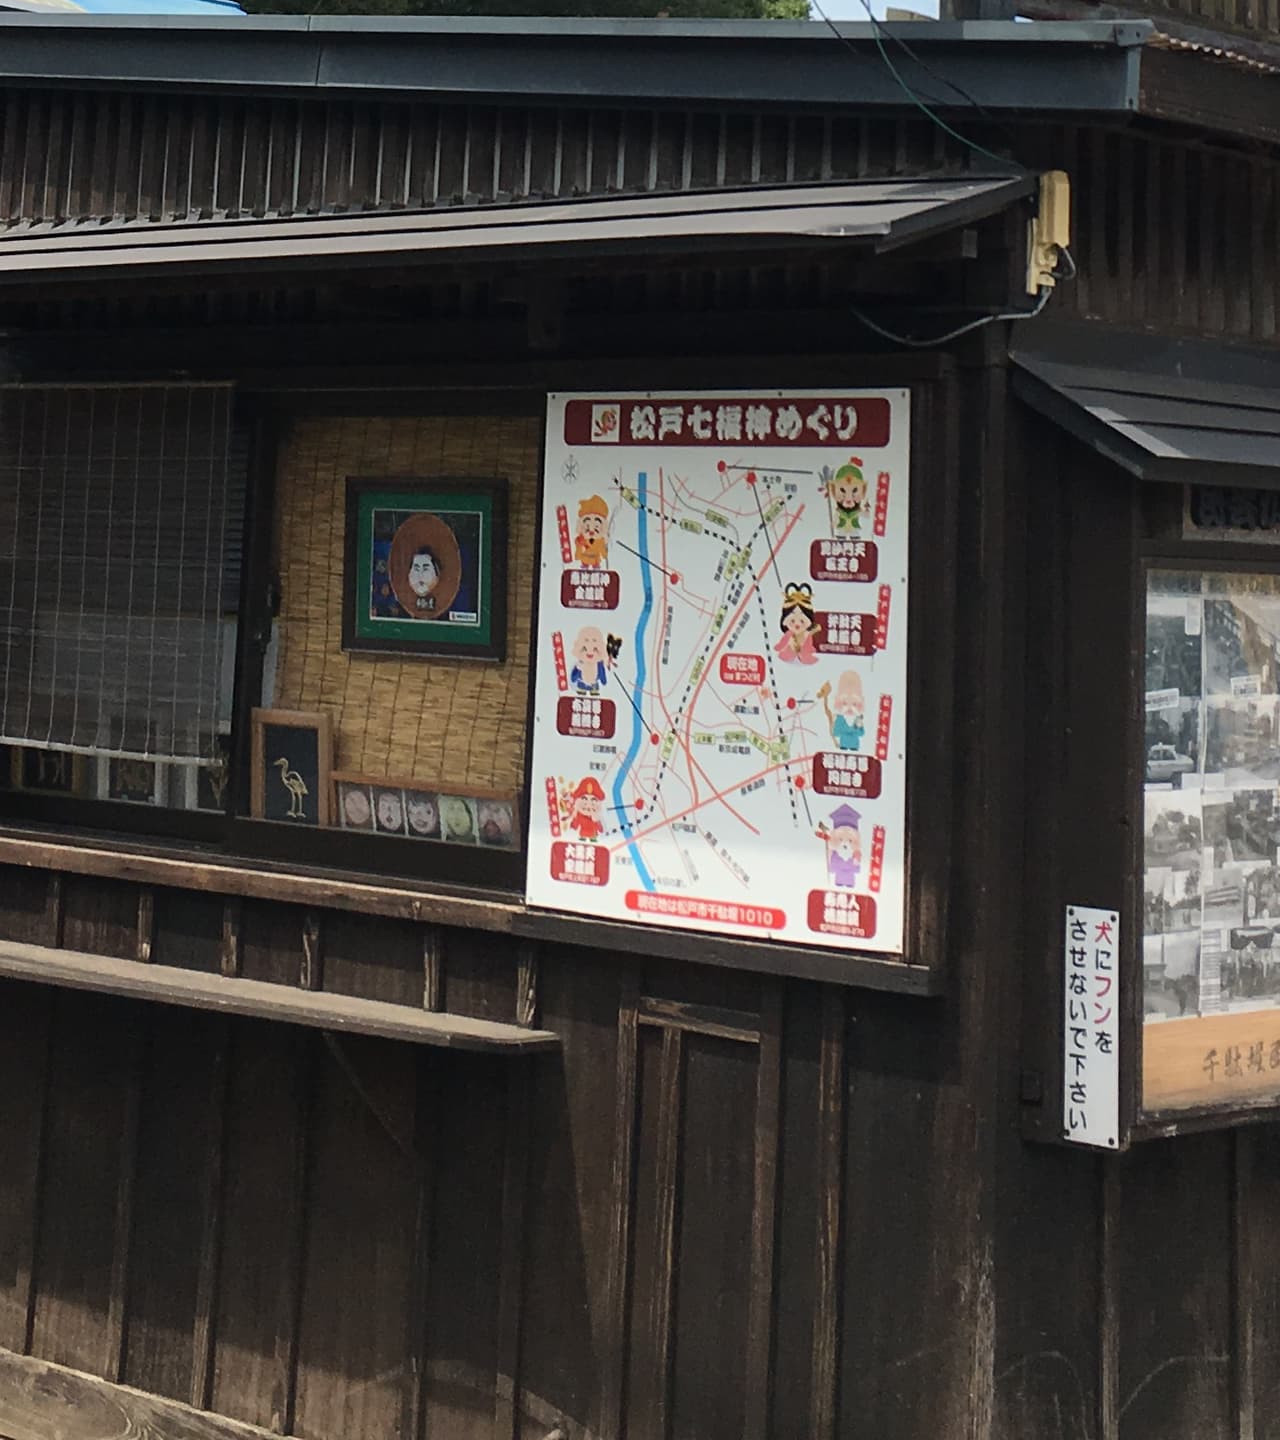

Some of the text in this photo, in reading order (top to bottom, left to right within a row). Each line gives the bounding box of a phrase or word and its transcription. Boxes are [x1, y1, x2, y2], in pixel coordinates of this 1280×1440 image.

[630, 404, 857, 441] 松戸七福神めぐり
[1069, 919, 1087, 1130] させないで下さい
[1094, 920, 1112, 1054] 犬にフンを
